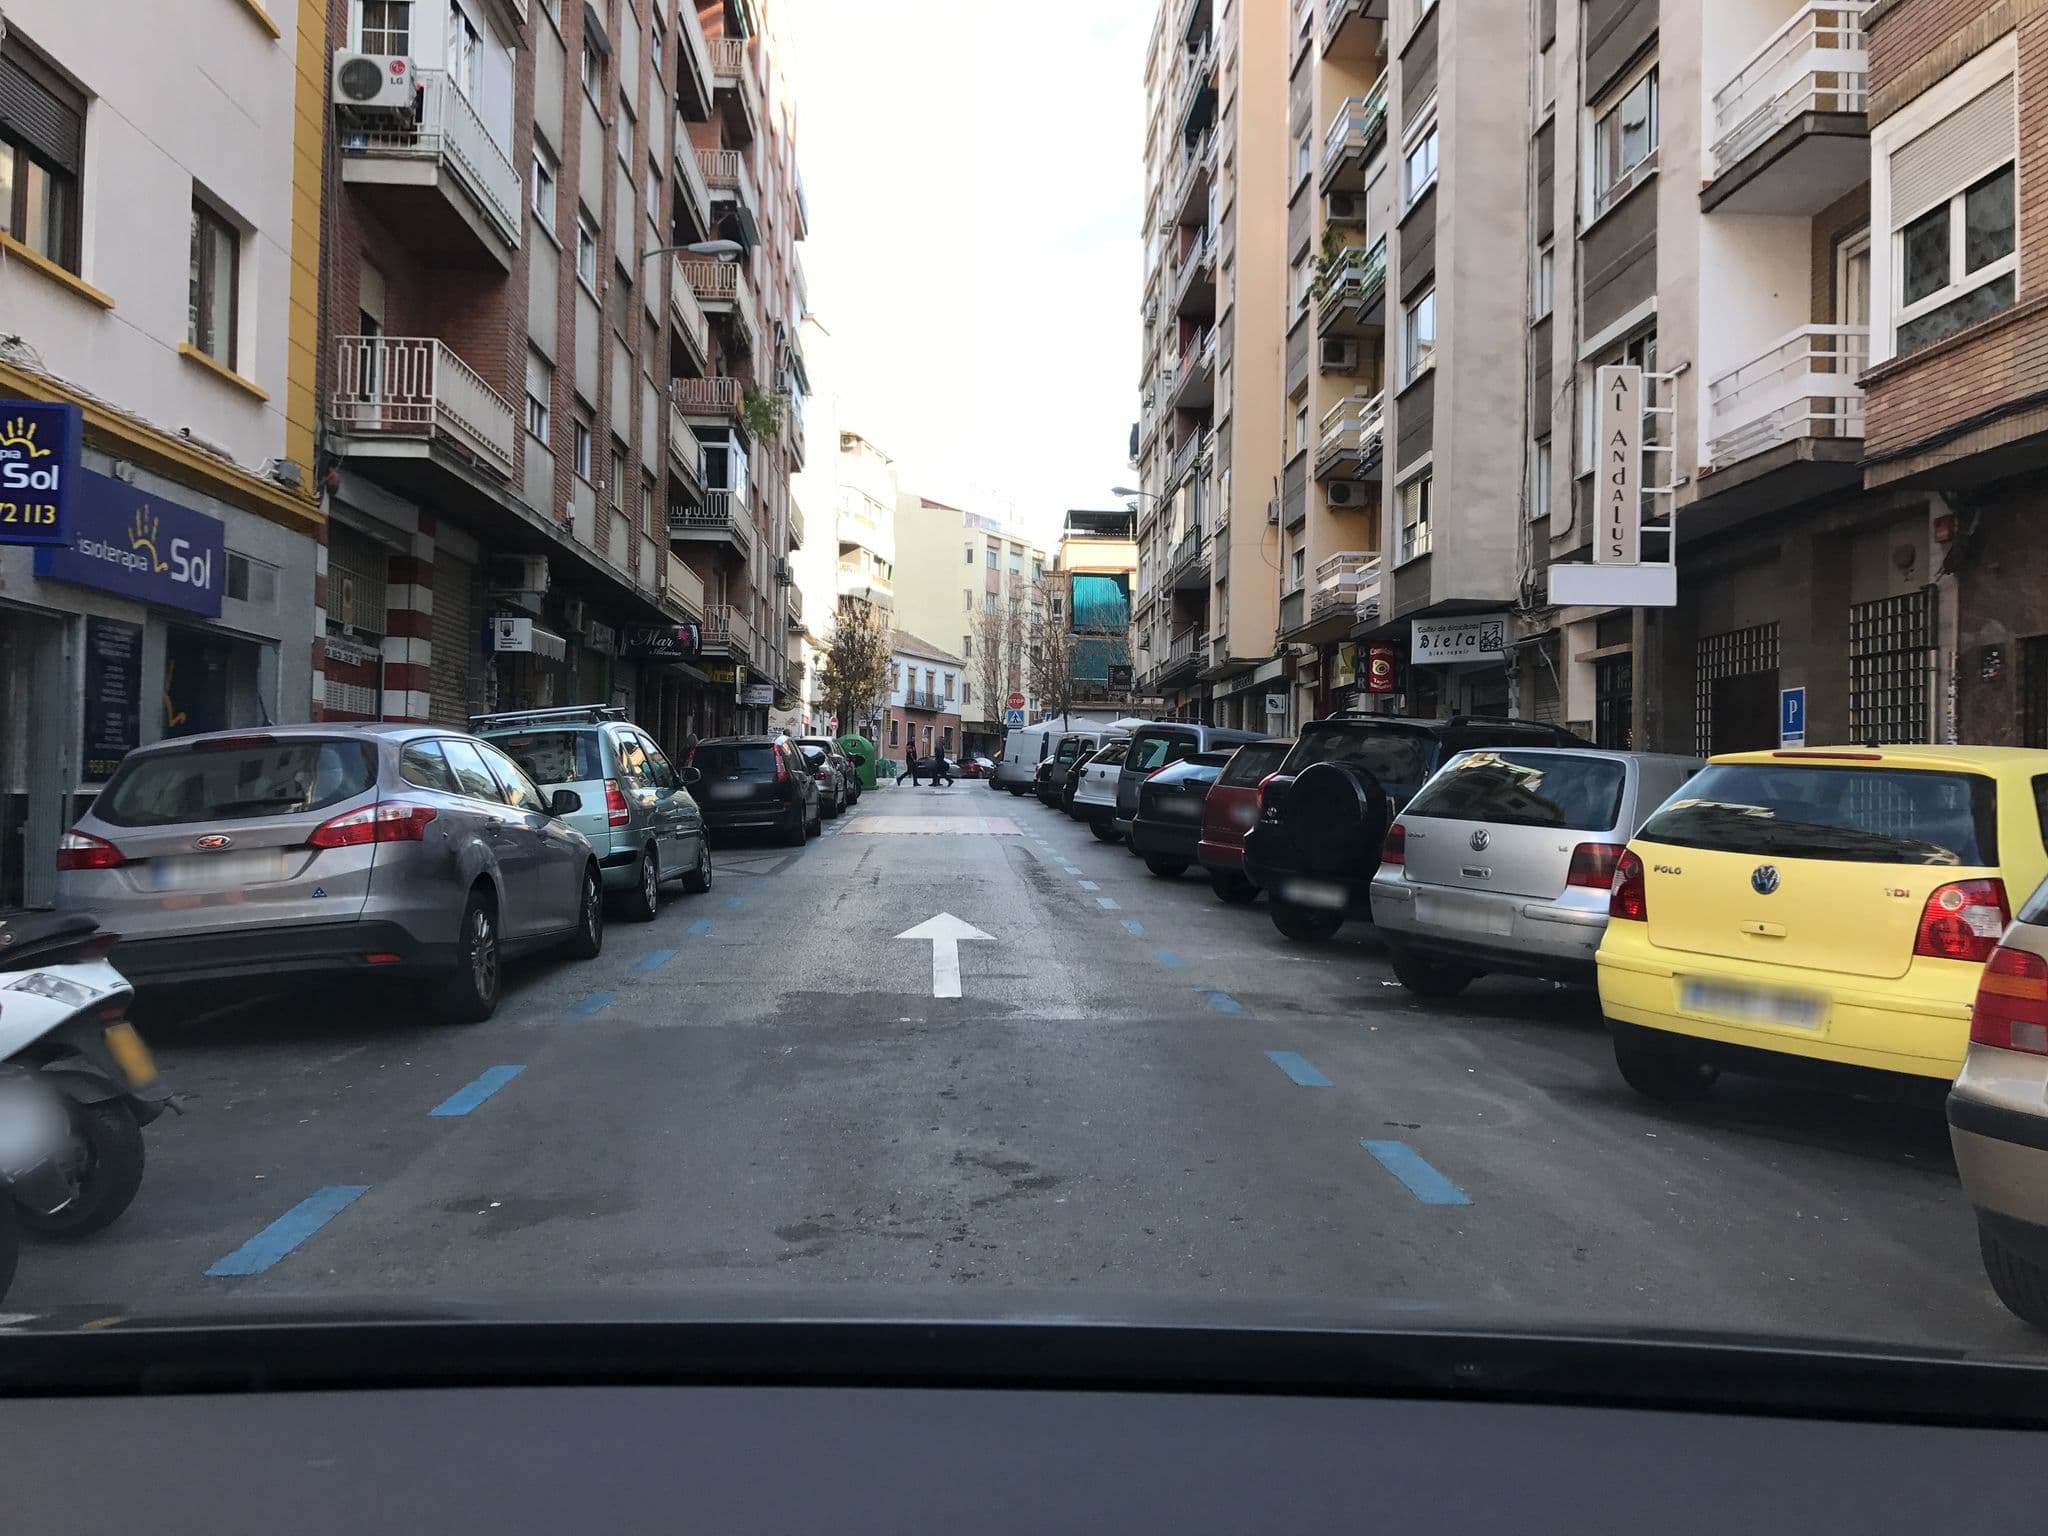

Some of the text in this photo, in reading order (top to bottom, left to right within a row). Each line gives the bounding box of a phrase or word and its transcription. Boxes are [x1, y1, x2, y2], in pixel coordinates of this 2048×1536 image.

[390, 77, 403, 85] LG
[2, 462, 60, 491] Sol
[24, 504, 56, 525] 113
[170, 537, 211, 590] Sol
[630, 628, 674, 648] Mar
[1420, 632, 1476, 649] Biela
[1653, 864, 1682, 875] POLO
[1884, 887, 1910, 898] TDI
